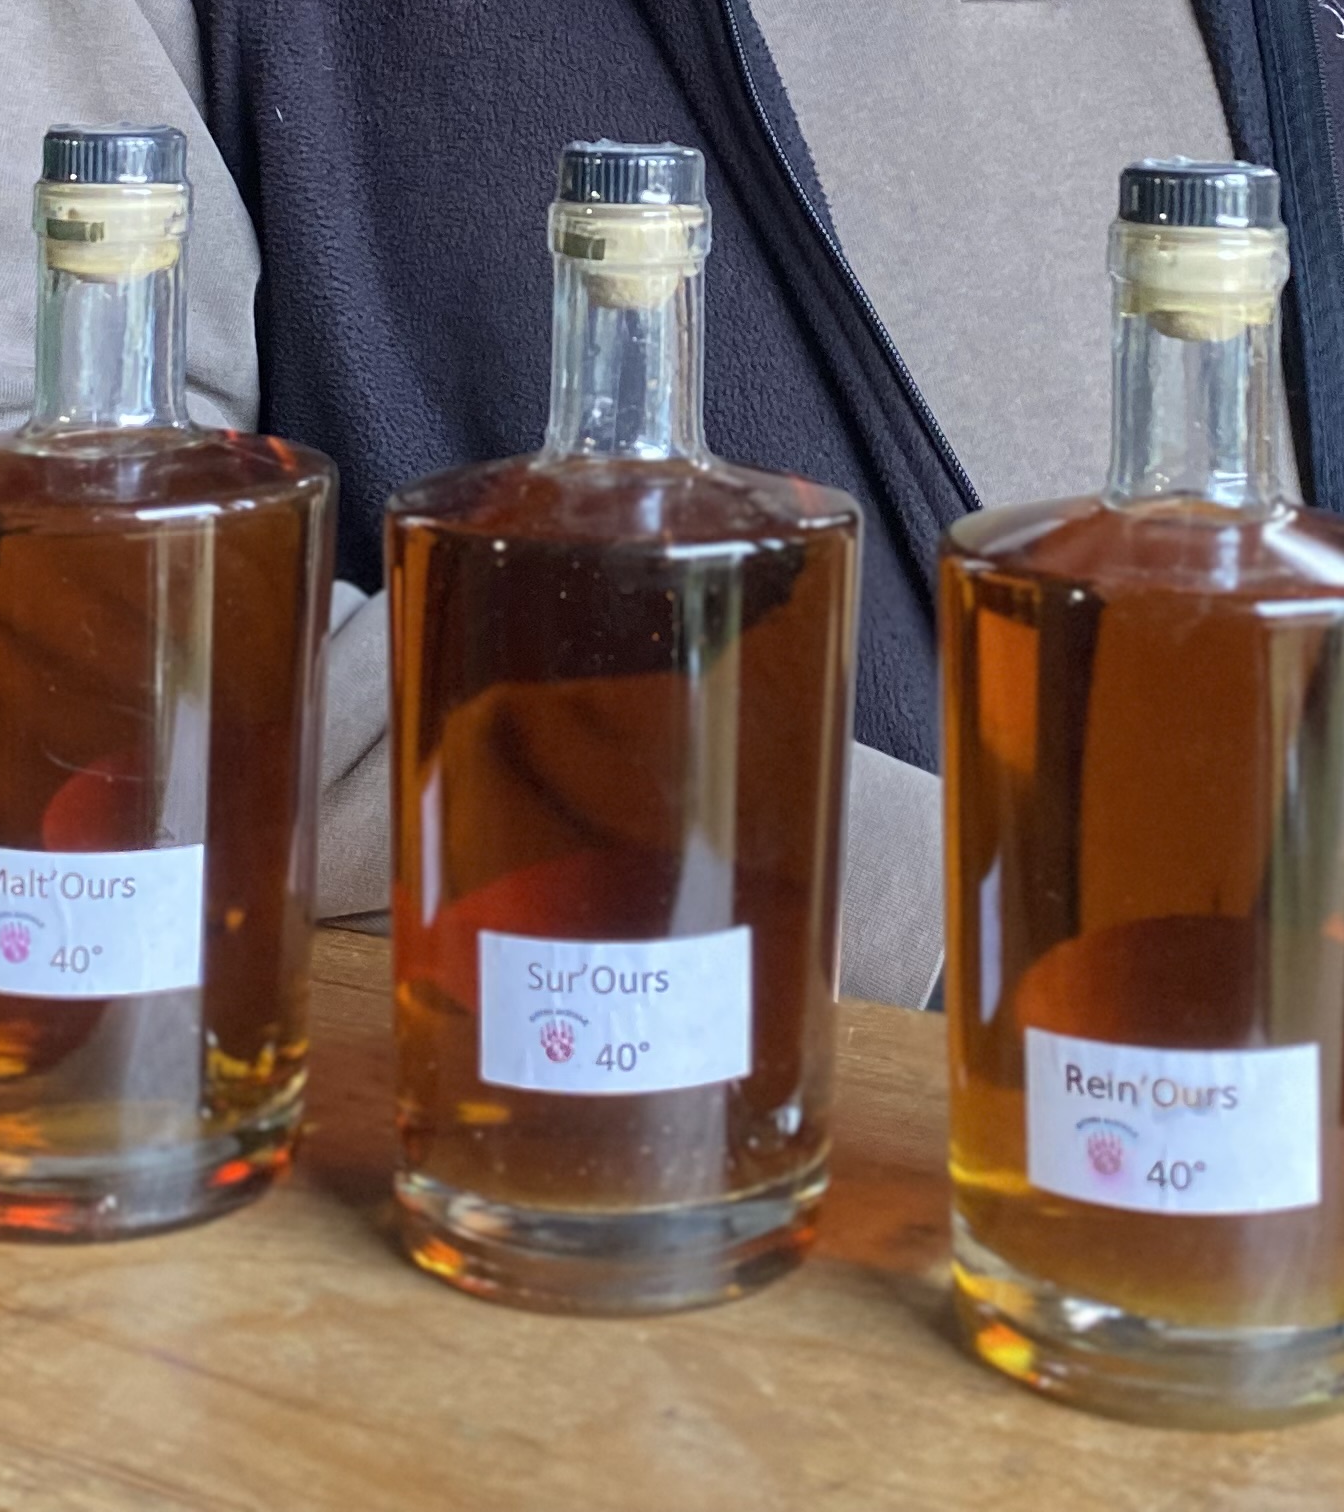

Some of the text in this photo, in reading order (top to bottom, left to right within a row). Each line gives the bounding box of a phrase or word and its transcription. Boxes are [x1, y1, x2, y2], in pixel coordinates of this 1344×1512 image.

[49, 945, 103, 974] 40°
[527, 961, 670, 995] Sur'Ours
[595, 1040, 651, 1072] 40°
[1064, 1063, 1239, 1110] Rein'Ours
[1146, 1160, 1206, 1191] 40°
